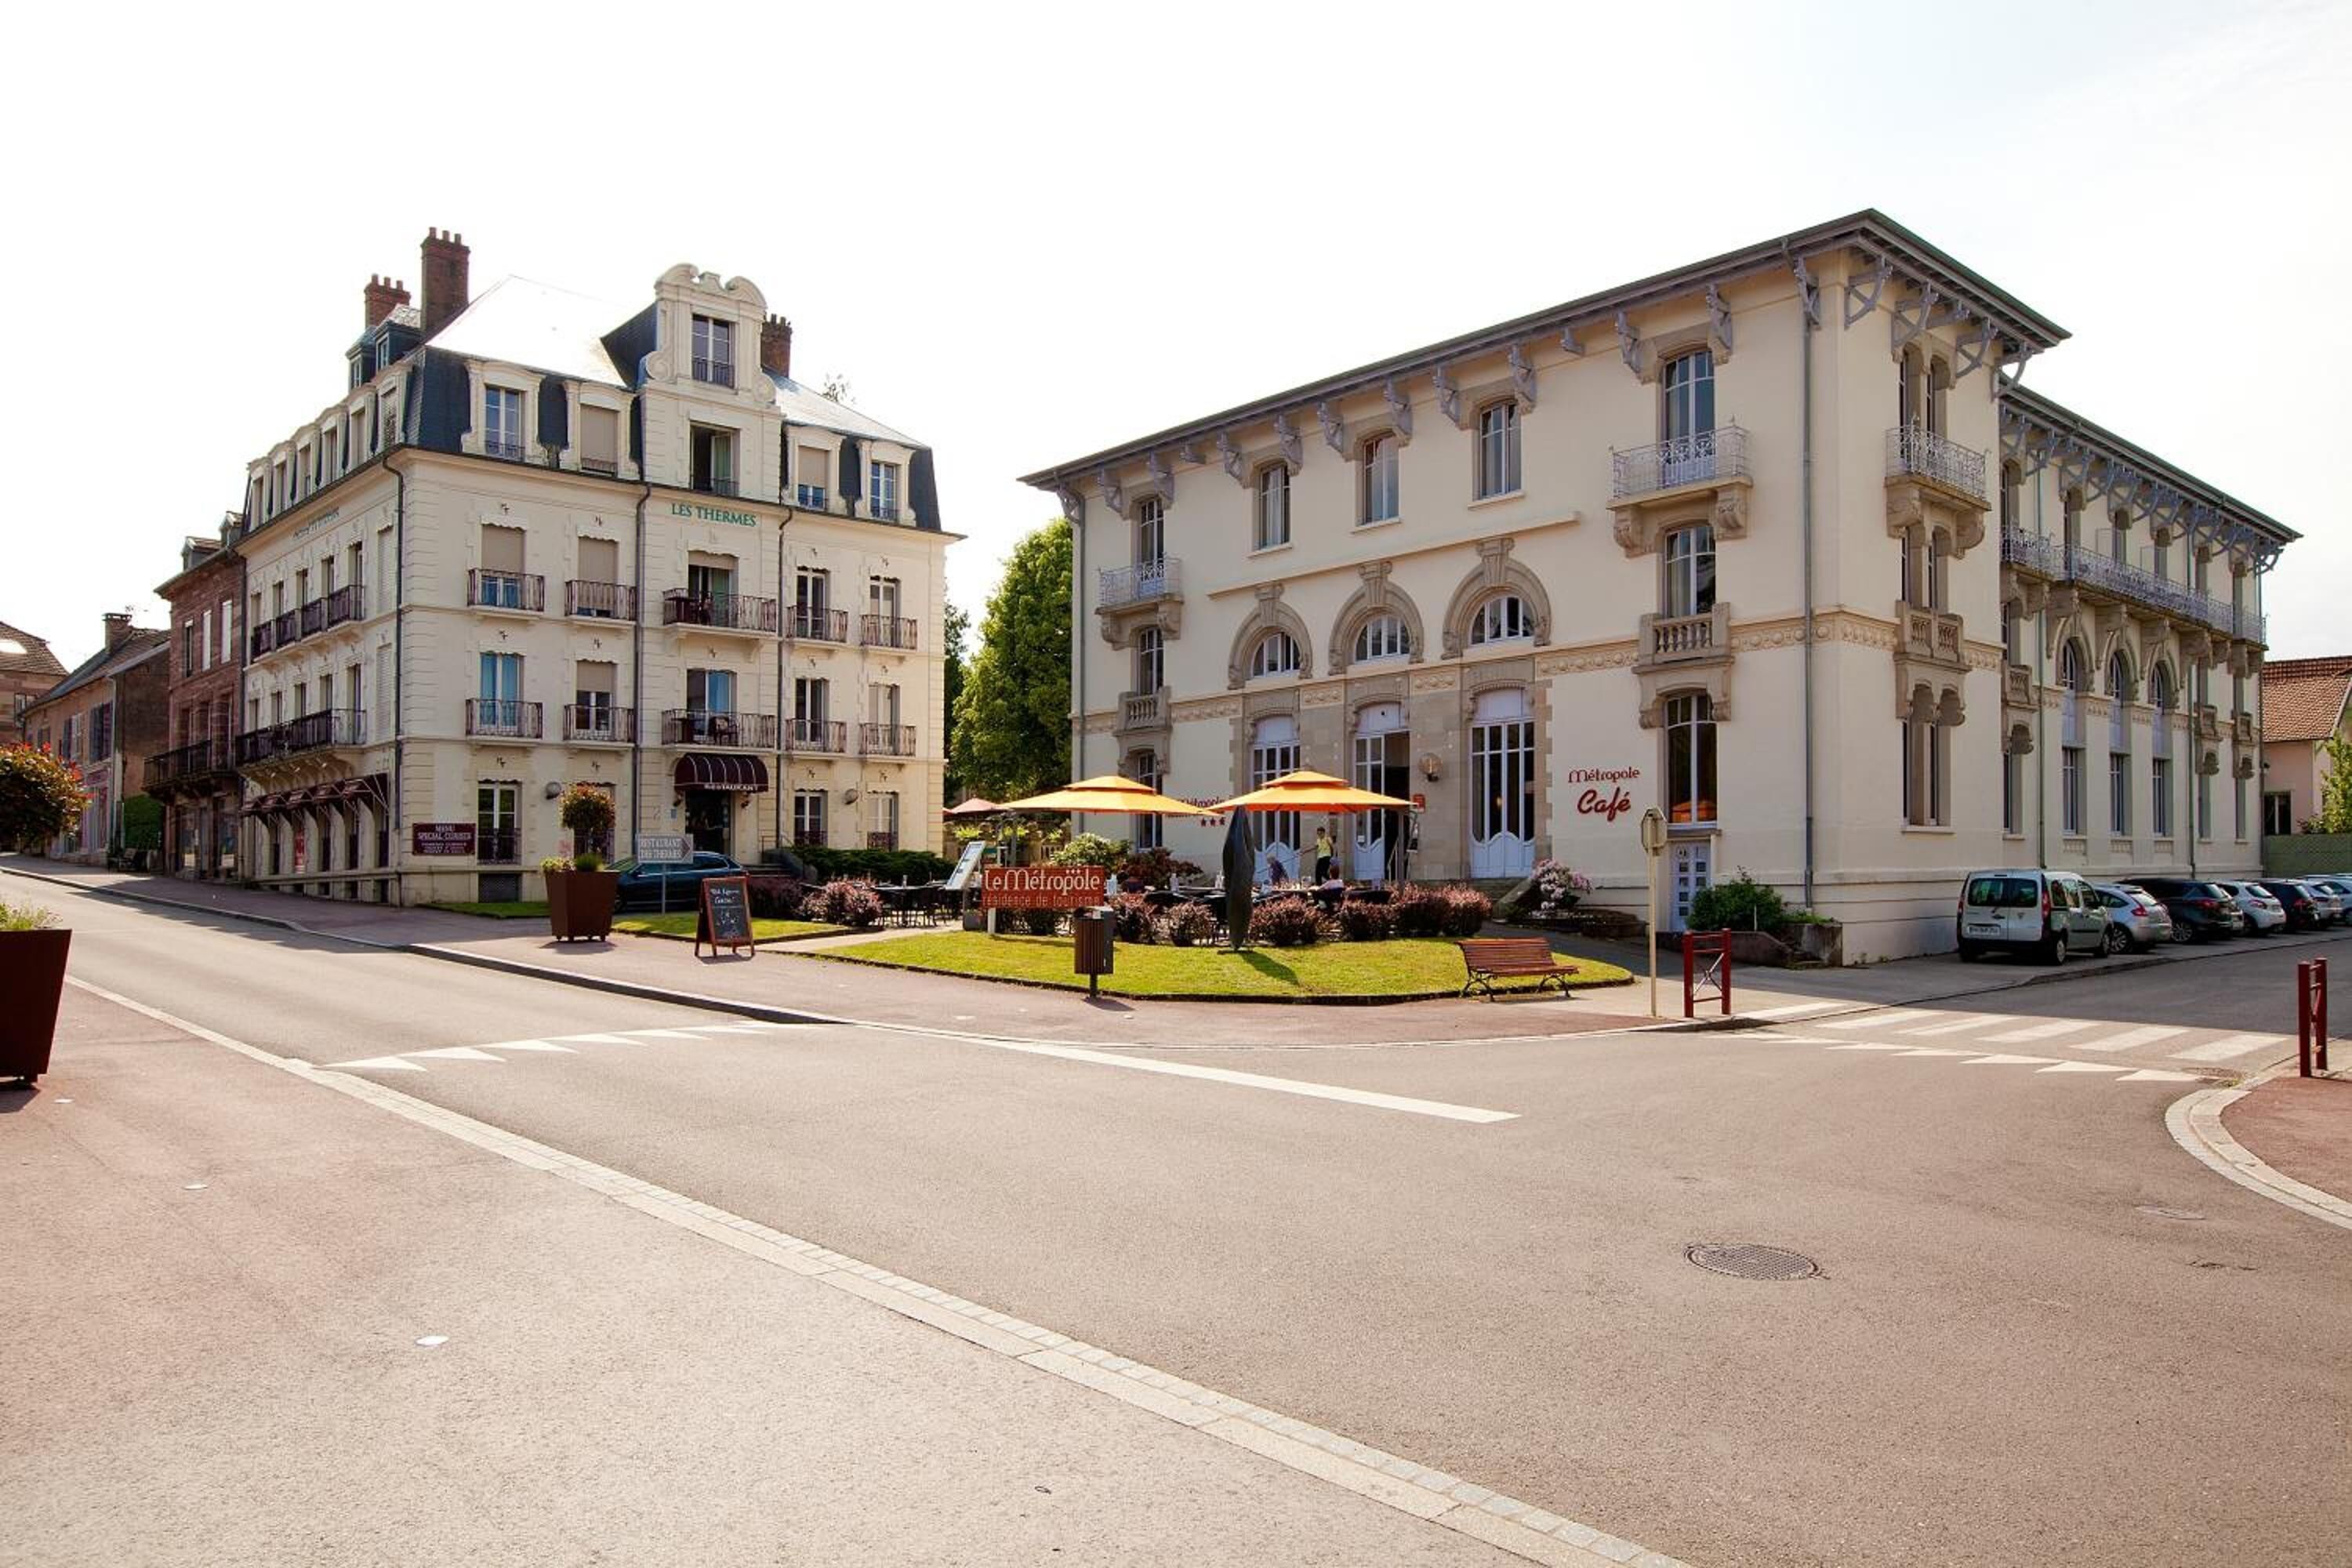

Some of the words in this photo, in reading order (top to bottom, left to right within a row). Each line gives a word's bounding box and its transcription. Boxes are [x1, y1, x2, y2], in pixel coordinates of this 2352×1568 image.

[672, 503, 691, 517] LES
[695, 506, 757, 528] THERMES
[1568, 766, 1640, 782] Métropole
[1577, 786, 1631, 822] Café
[982, 895, 1030, 907] résidence
[1036, 895, 1048, 907] de
[1053, 895, 1099, 907] tourisme
